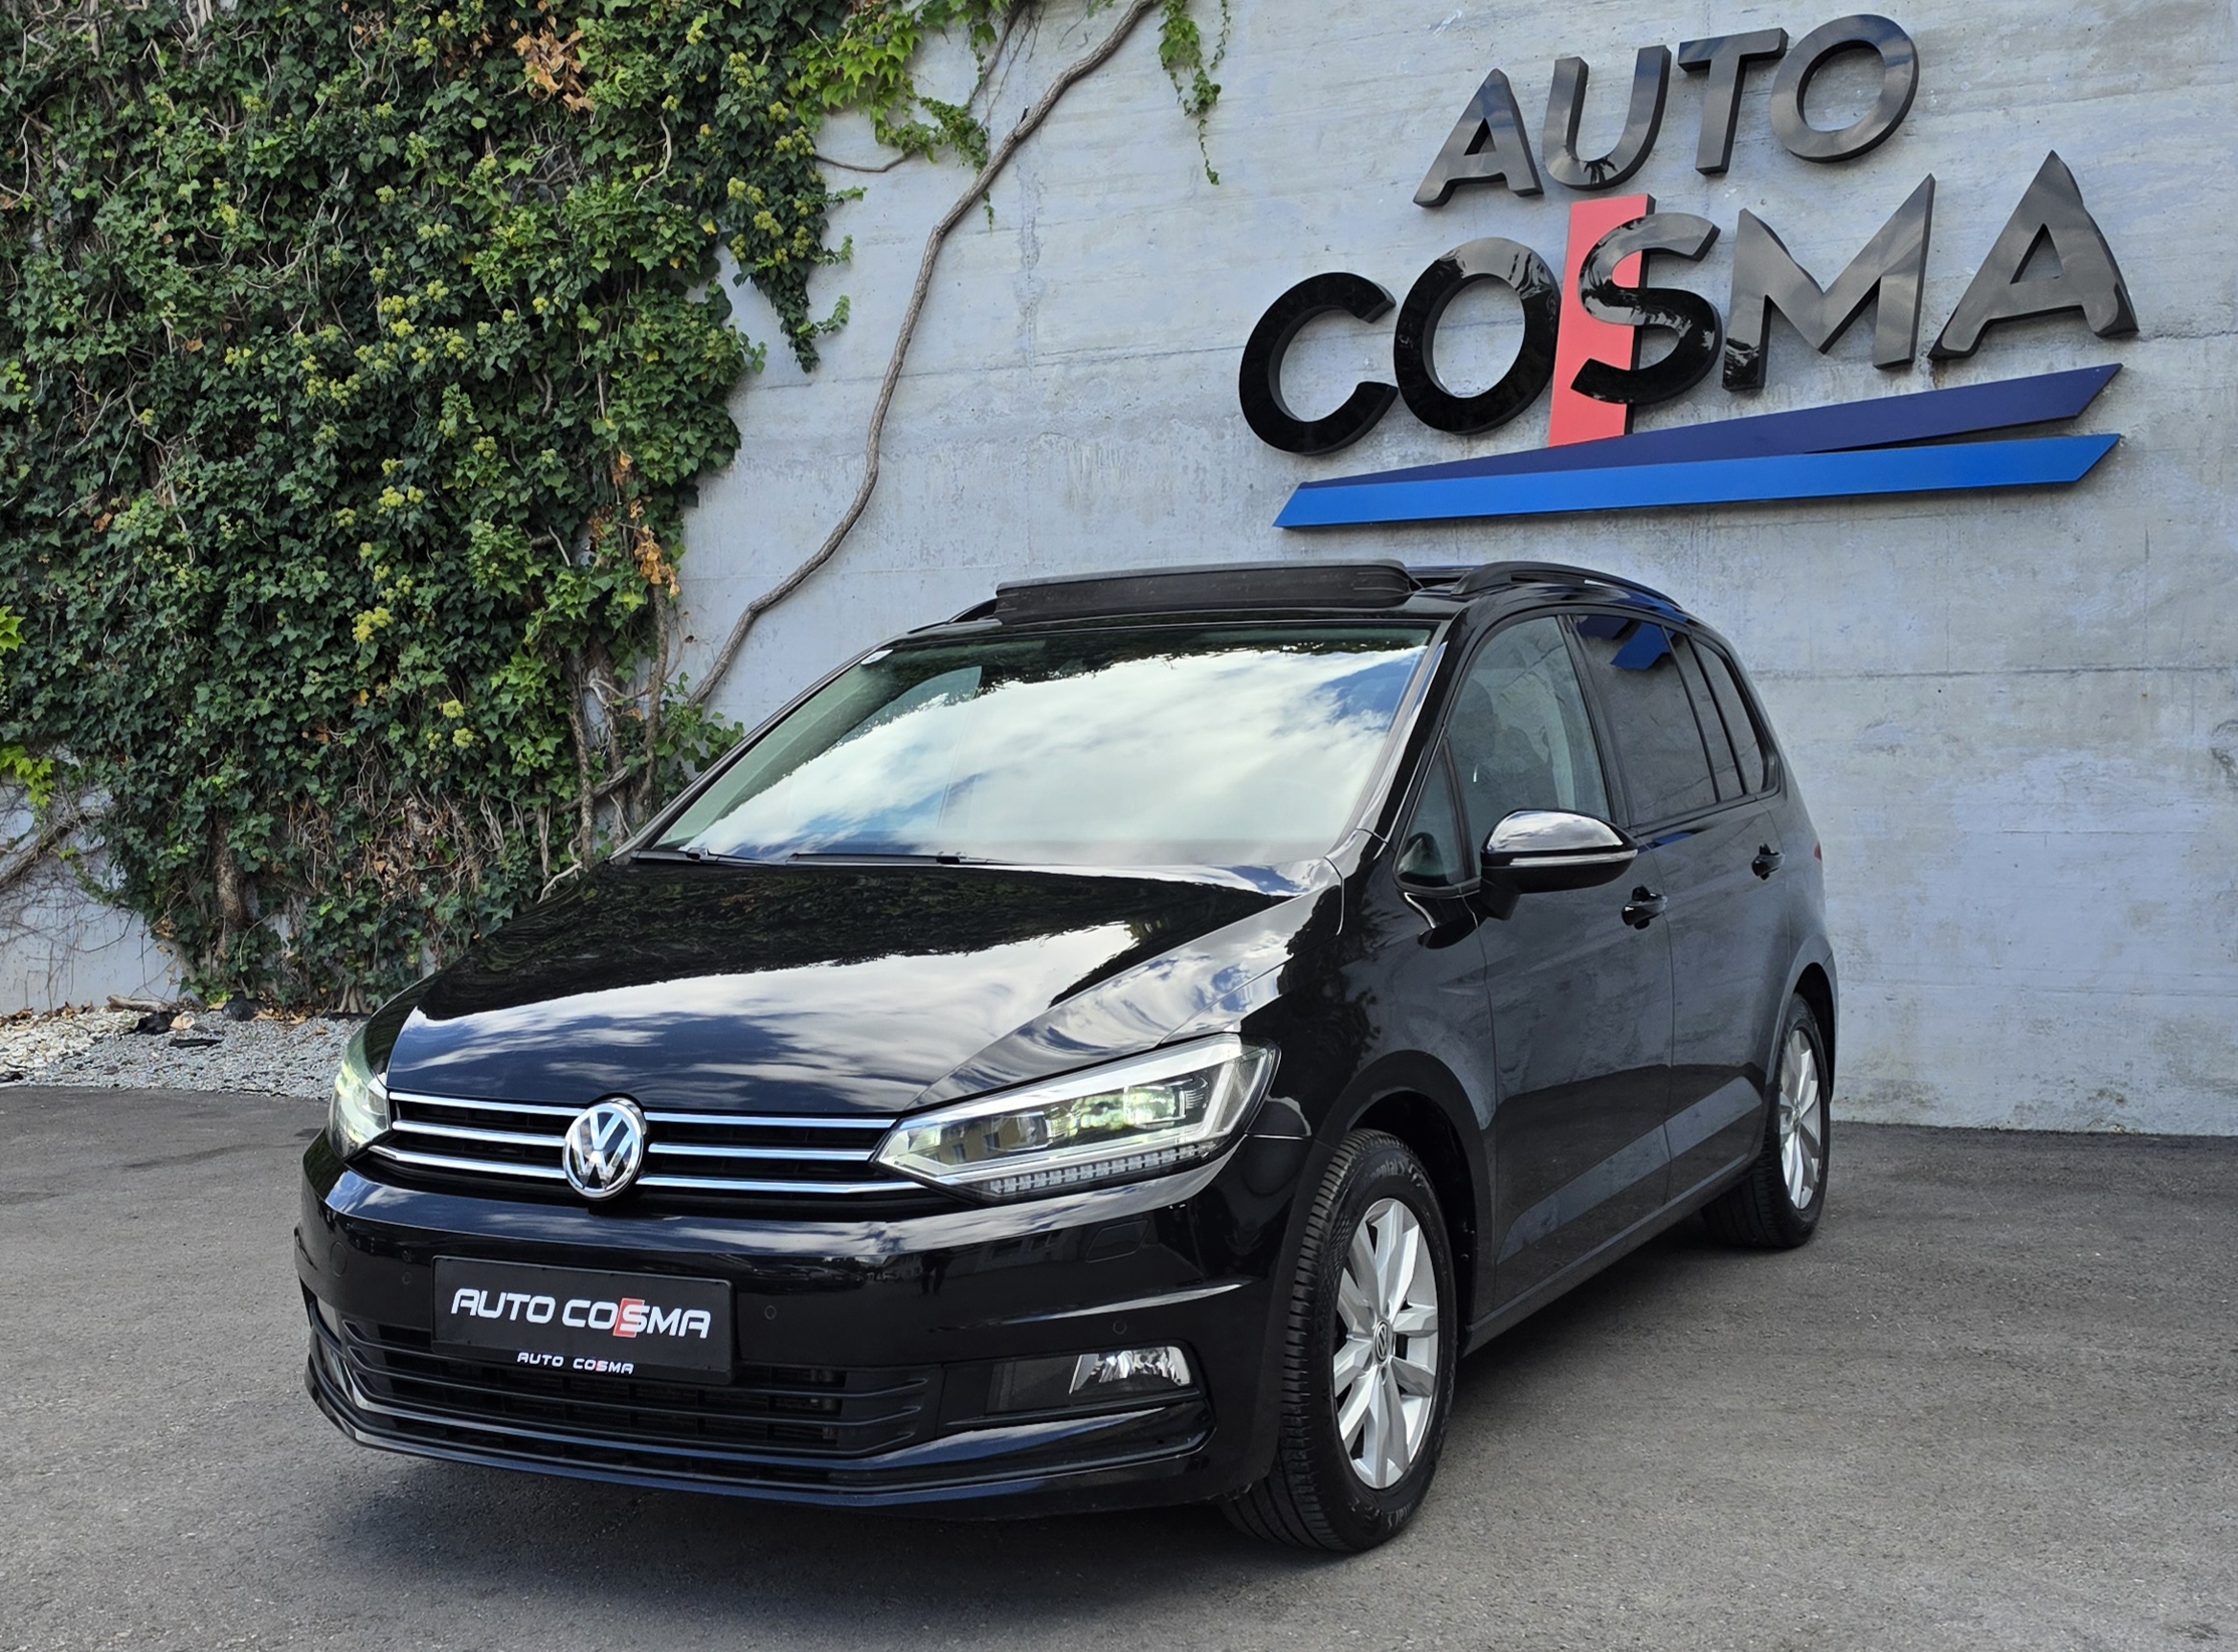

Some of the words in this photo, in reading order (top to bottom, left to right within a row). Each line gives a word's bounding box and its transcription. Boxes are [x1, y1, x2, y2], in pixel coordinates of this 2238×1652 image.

[1413, 13, 1918, 207] AUTO
[1239, 149, 2139, 456] COSMA
[450, 1288, 556, 1324] AUTO
[561, 1299, 711, 1339] COSMA
[516, 1351, 564, 1368] AUTO
[572, 1357, 635, 1375] COSMA
